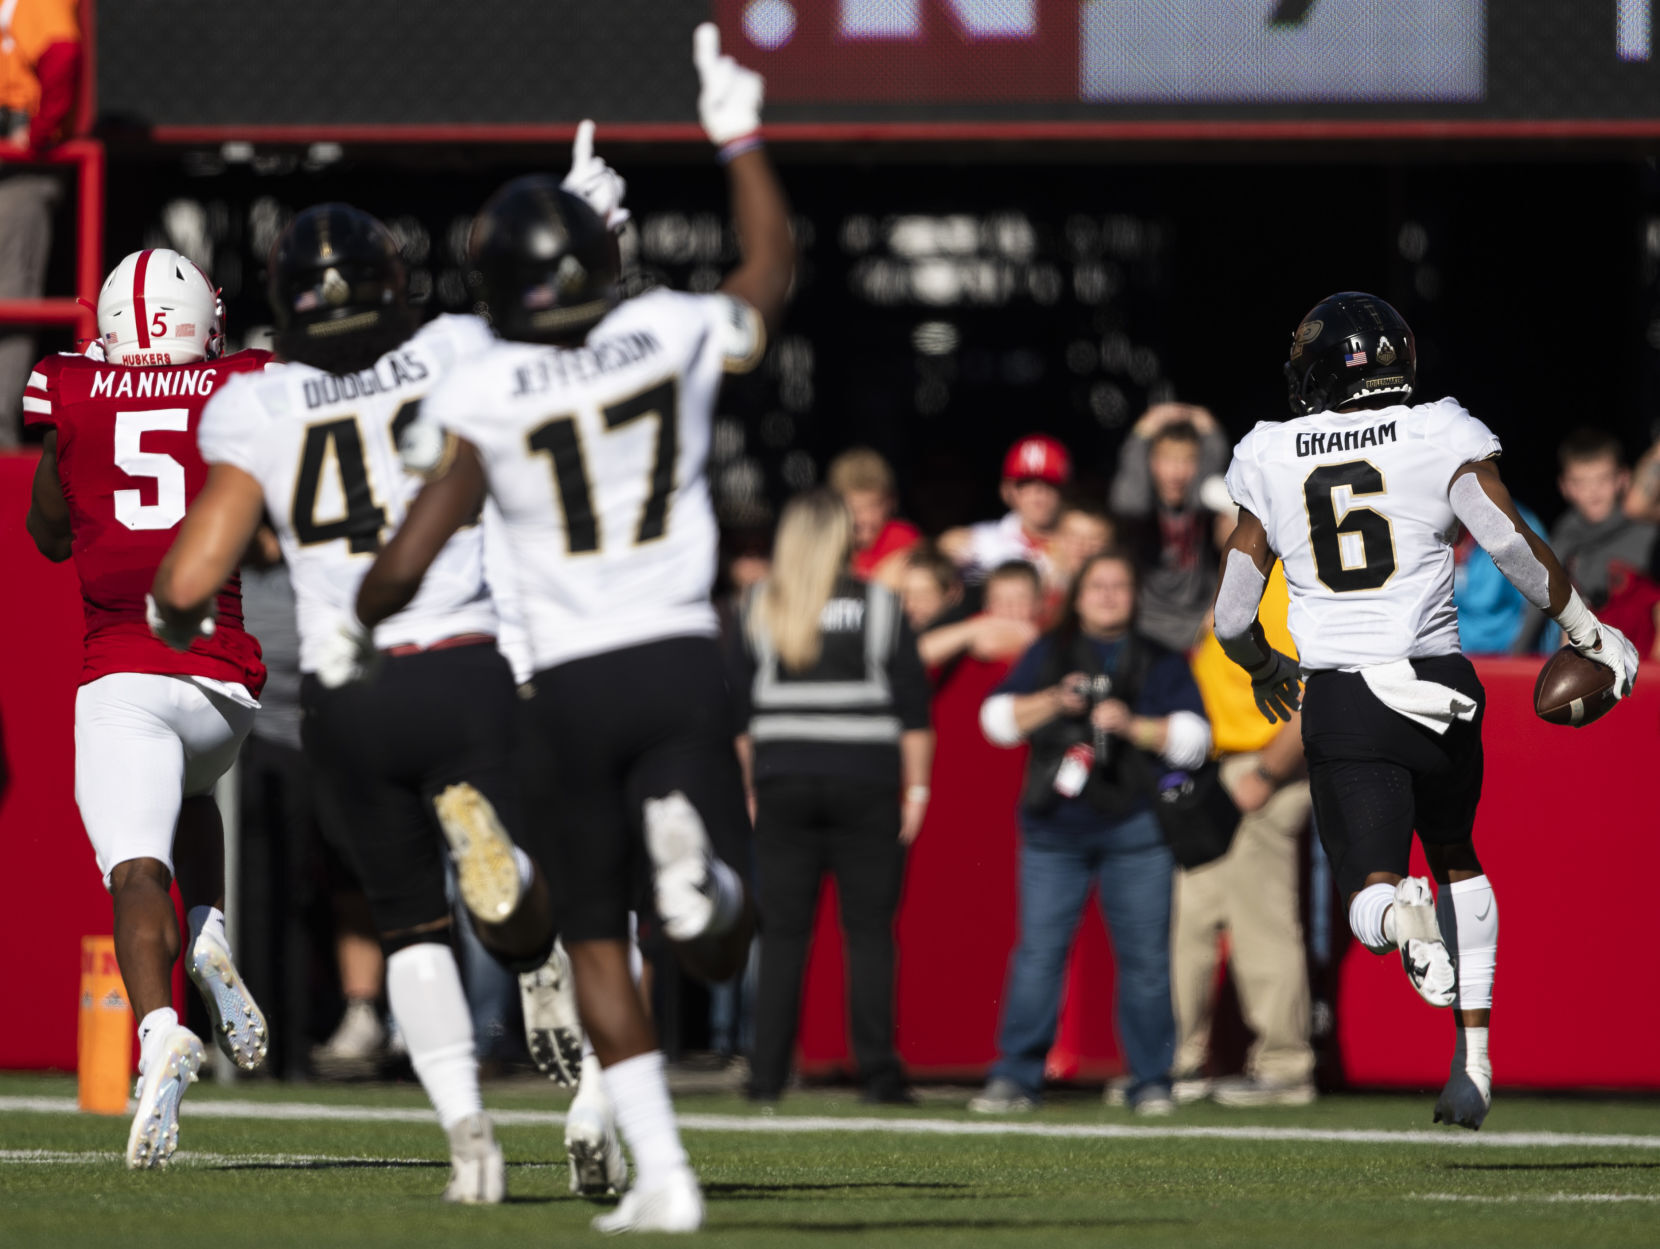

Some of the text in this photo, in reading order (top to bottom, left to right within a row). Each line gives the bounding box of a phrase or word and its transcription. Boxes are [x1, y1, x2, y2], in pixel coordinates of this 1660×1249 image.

[150, 312, 168, 338] 5
[90, 368, 217, 399] MANNING
[122, 353, 172, 366] HUSKERS
[303, 350, 429, 409] DOUGLAS
[512, 328, 664, 397] JEFFERSON
[526, 372, 680, 557] 17
[1295, 421, 1398, 457] GRAHAM
[114, 408, 190, 531] 5
[1303, 458, 1399, 594] 6
